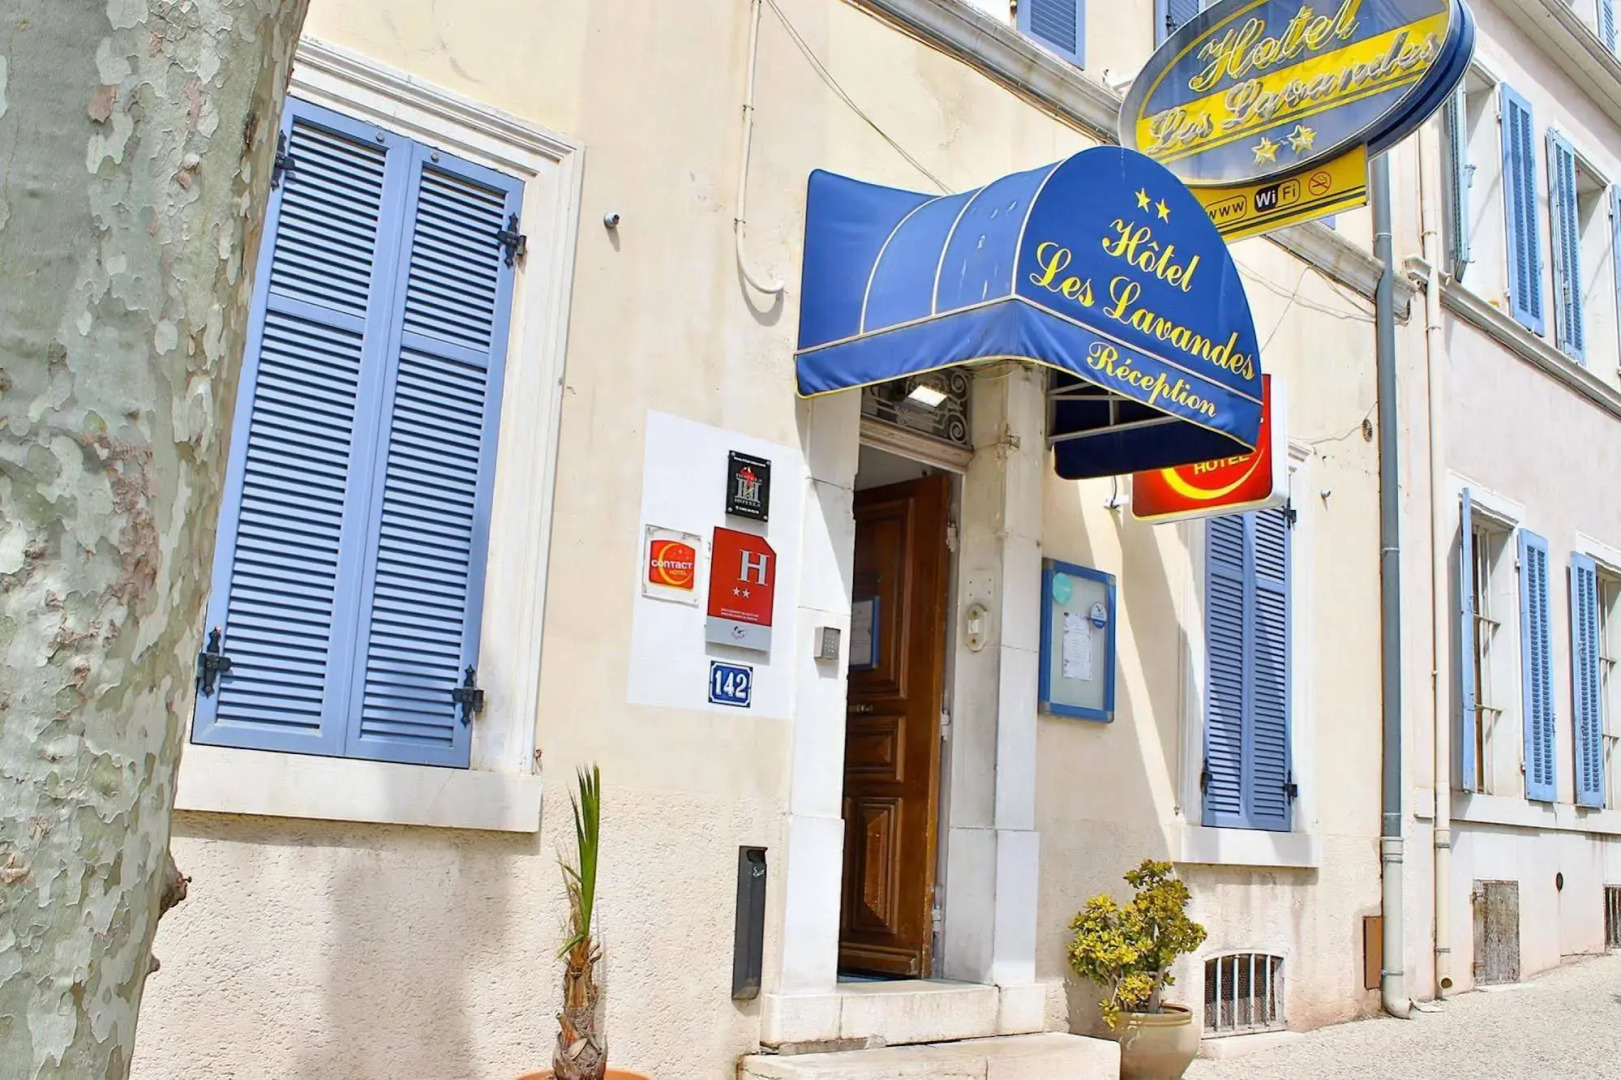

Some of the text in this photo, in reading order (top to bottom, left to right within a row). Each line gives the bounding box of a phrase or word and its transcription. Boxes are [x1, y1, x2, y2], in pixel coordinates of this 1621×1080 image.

[1188, 0, 1360, 92] Hotel
[1145, 30, 1440, 155] Les Lavandes
[1102, 219, 1200, 292] Hôtel
[1029, 241, 1255, 381] Les Lavandes
[1086, 341, 1217, 418] Réception
[737, 548, 770, 587] H
[715, 669, 748, 699] 142
